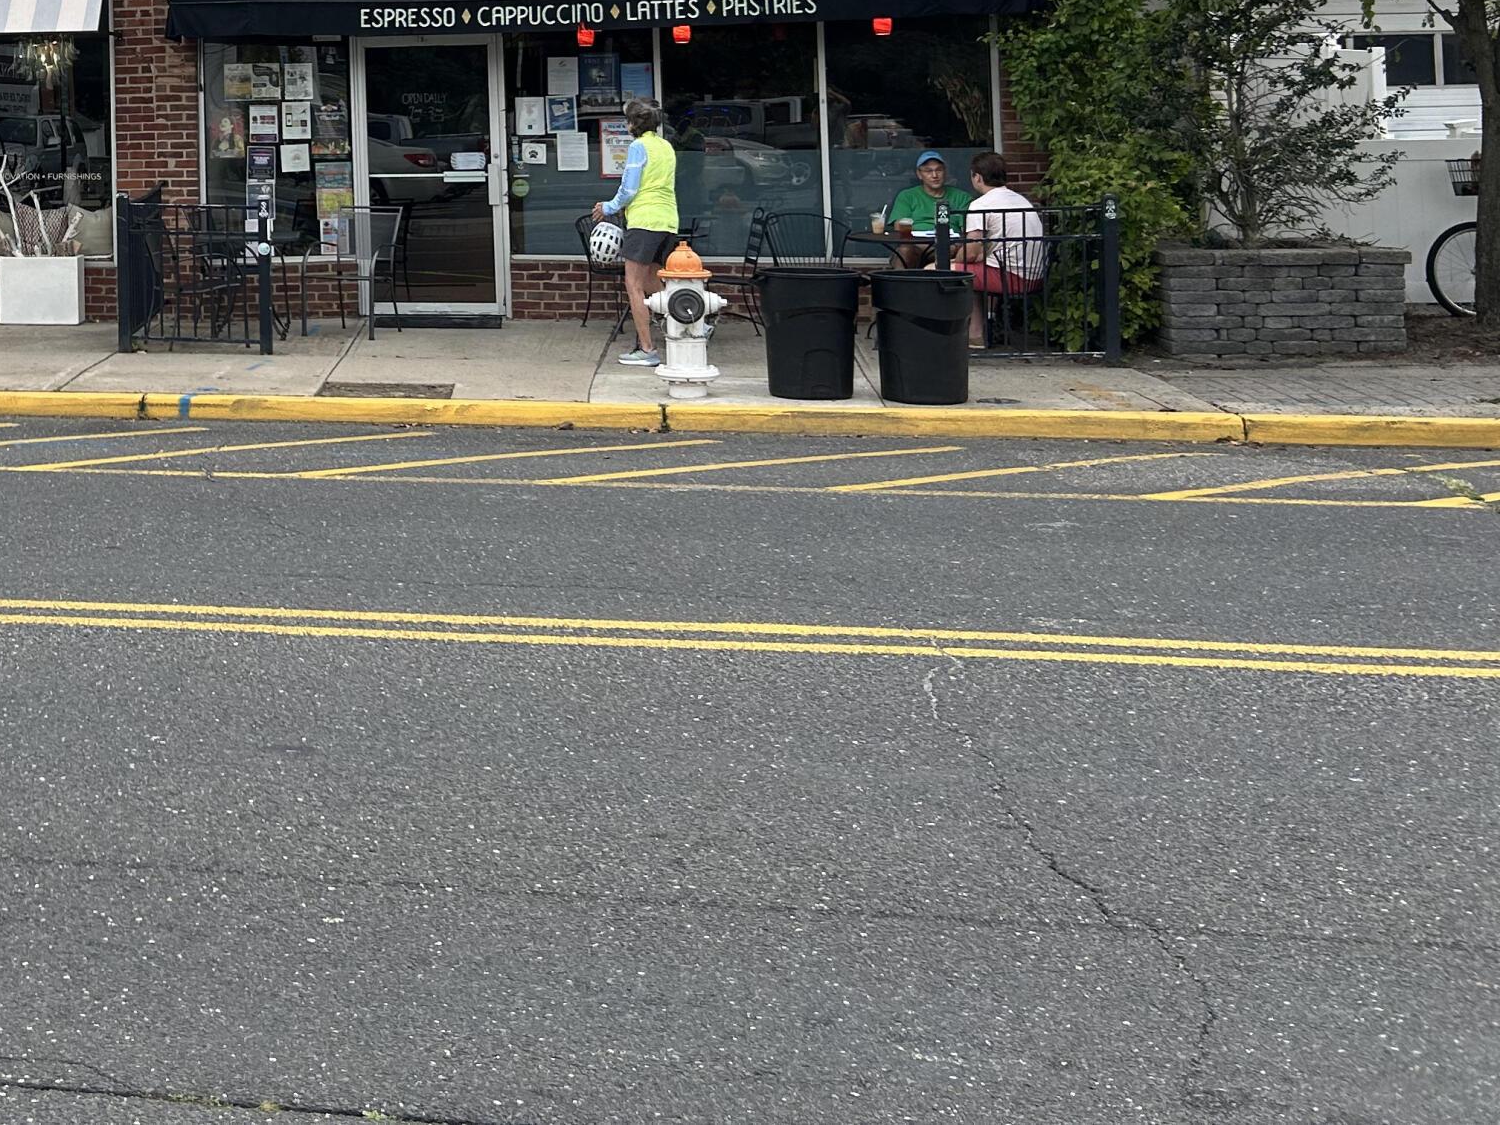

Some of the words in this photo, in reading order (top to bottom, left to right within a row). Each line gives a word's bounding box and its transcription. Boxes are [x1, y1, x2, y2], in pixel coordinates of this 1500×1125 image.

[360, 6, 456, 28] ESPRESSO
[477, 2, 604, 26] CAPPUCCINO
[47, 172, 102, 181] FURNISHINGS
